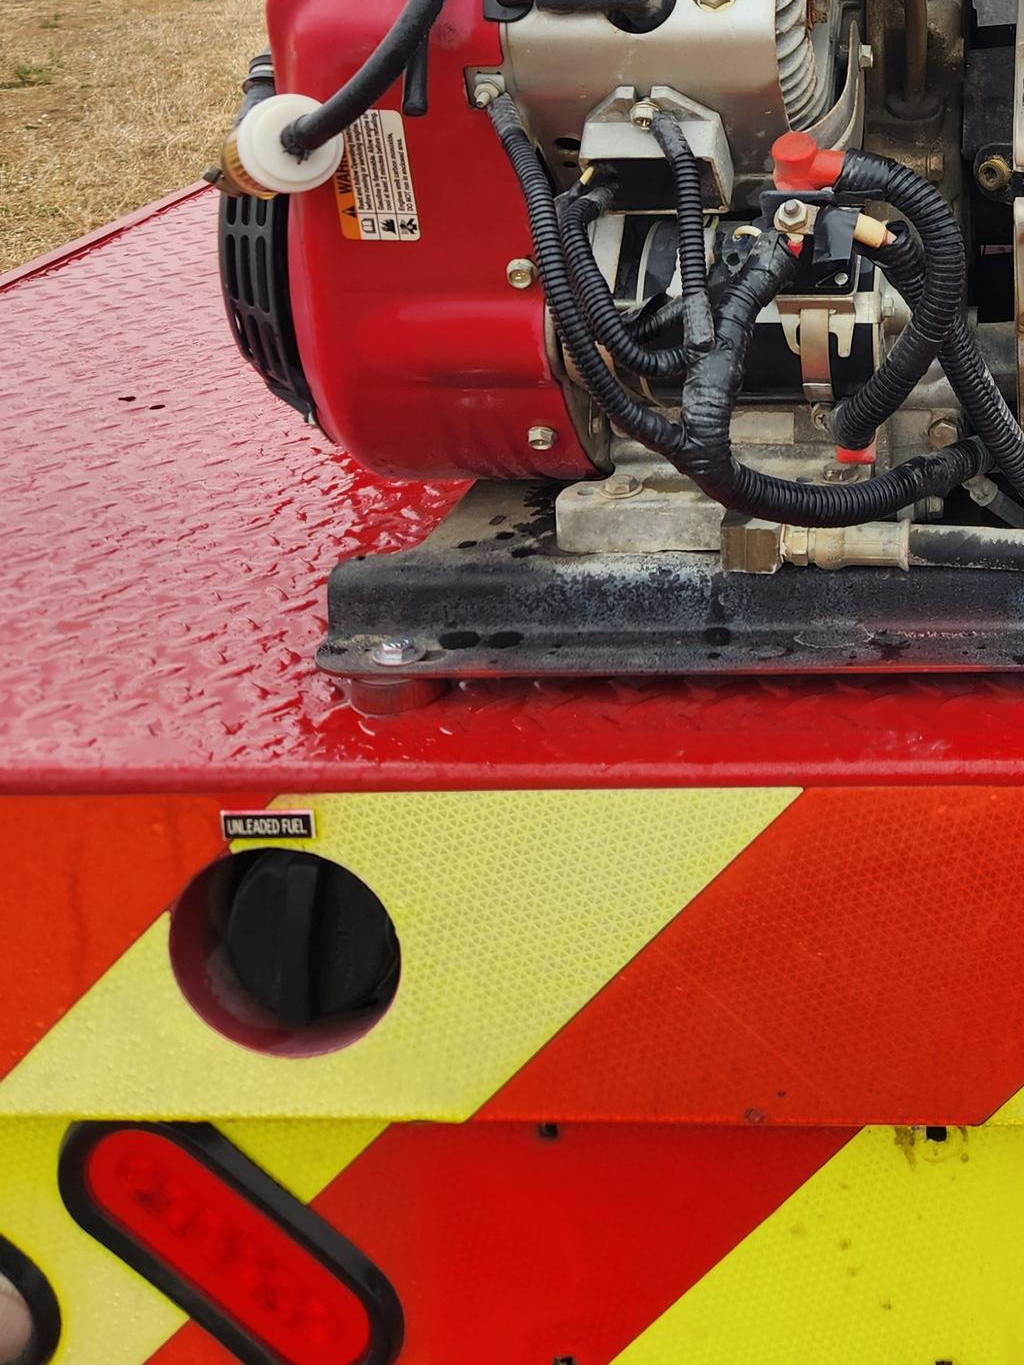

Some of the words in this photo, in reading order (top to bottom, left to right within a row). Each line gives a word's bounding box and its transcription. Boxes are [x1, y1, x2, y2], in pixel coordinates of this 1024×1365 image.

[407, 203, 413, 211] DO
[226, 818, 279, 835] UNLEADED
[281, 818, 307, 834] FUEL
